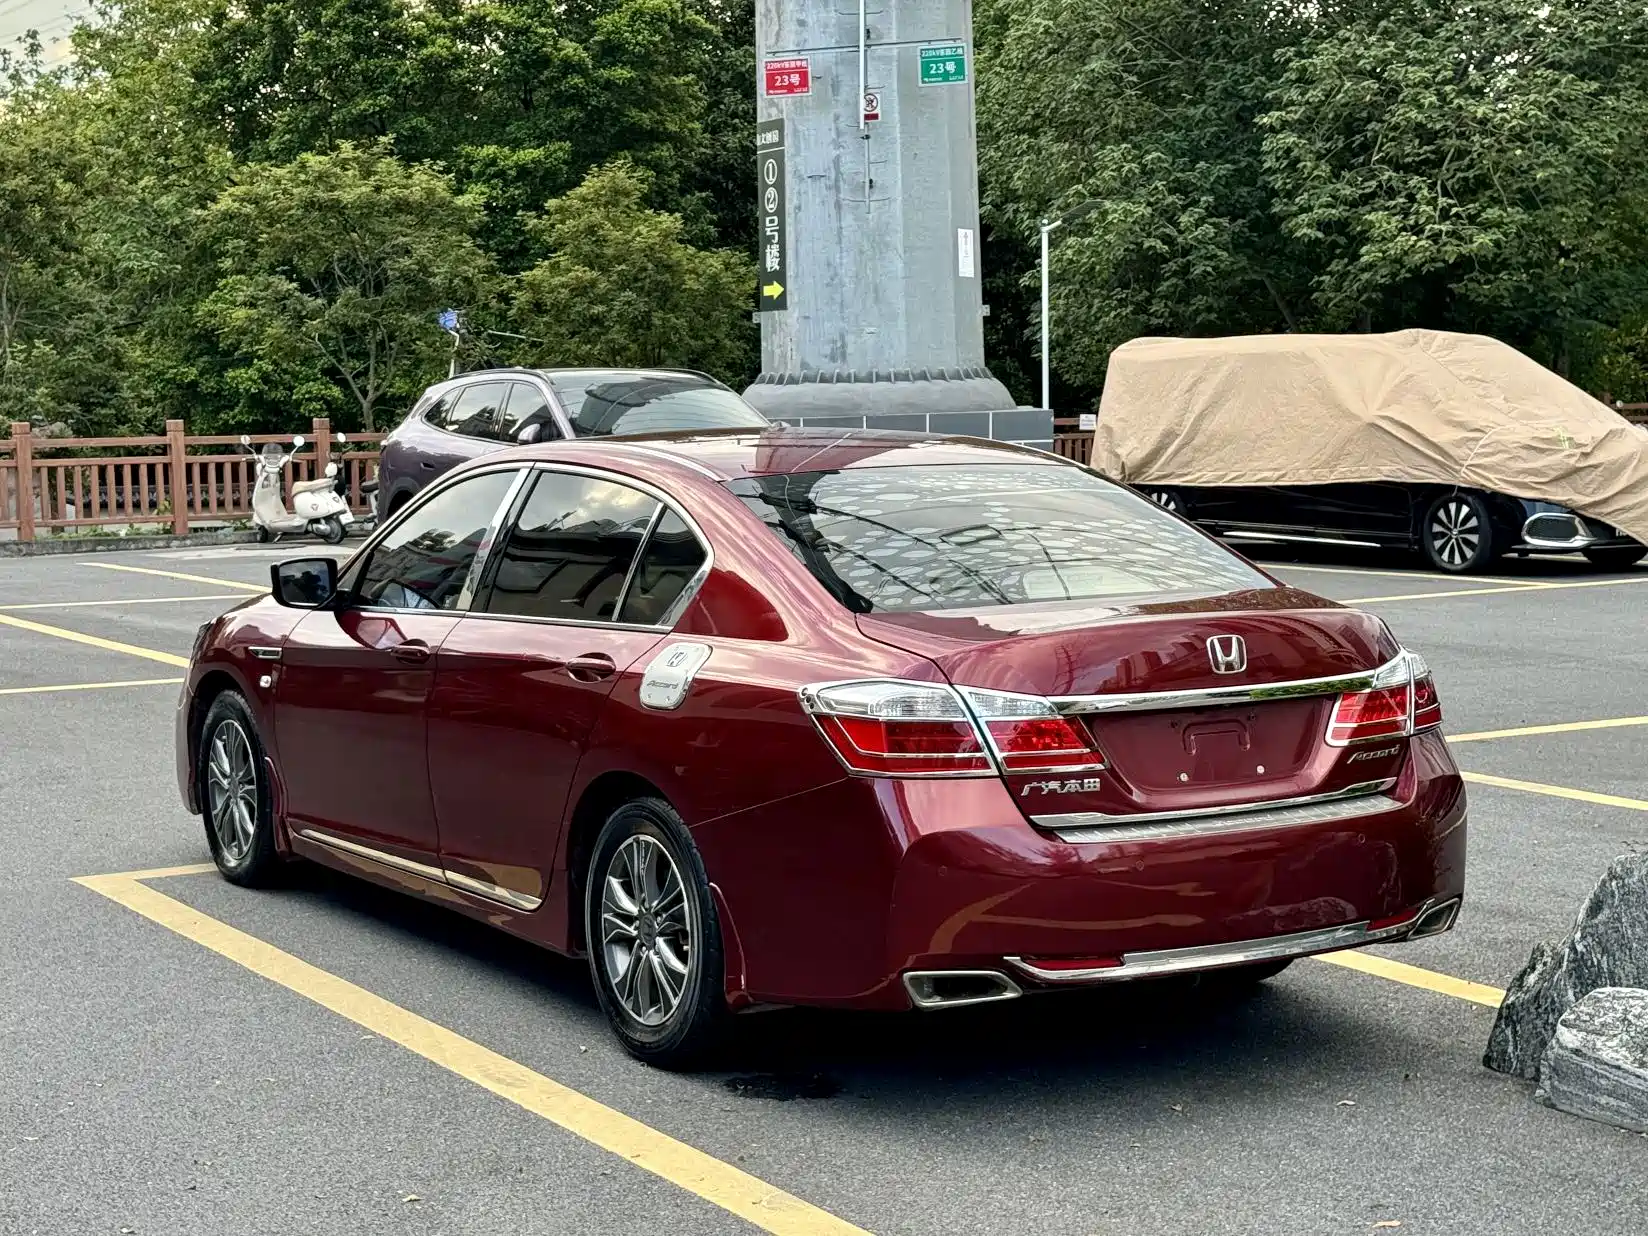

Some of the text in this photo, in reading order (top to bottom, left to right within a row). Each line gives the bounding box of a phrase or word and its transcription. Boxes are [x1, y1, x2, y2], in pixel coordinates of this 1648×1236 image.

[929, 62, 956, 74] 23号
[774, 73, 801, 87] 23号
[647, 680, 679, 689] Accord
[1347, 744, 1400, 764] Accord
[1021, 778, 1100, 796] 广汽本田
